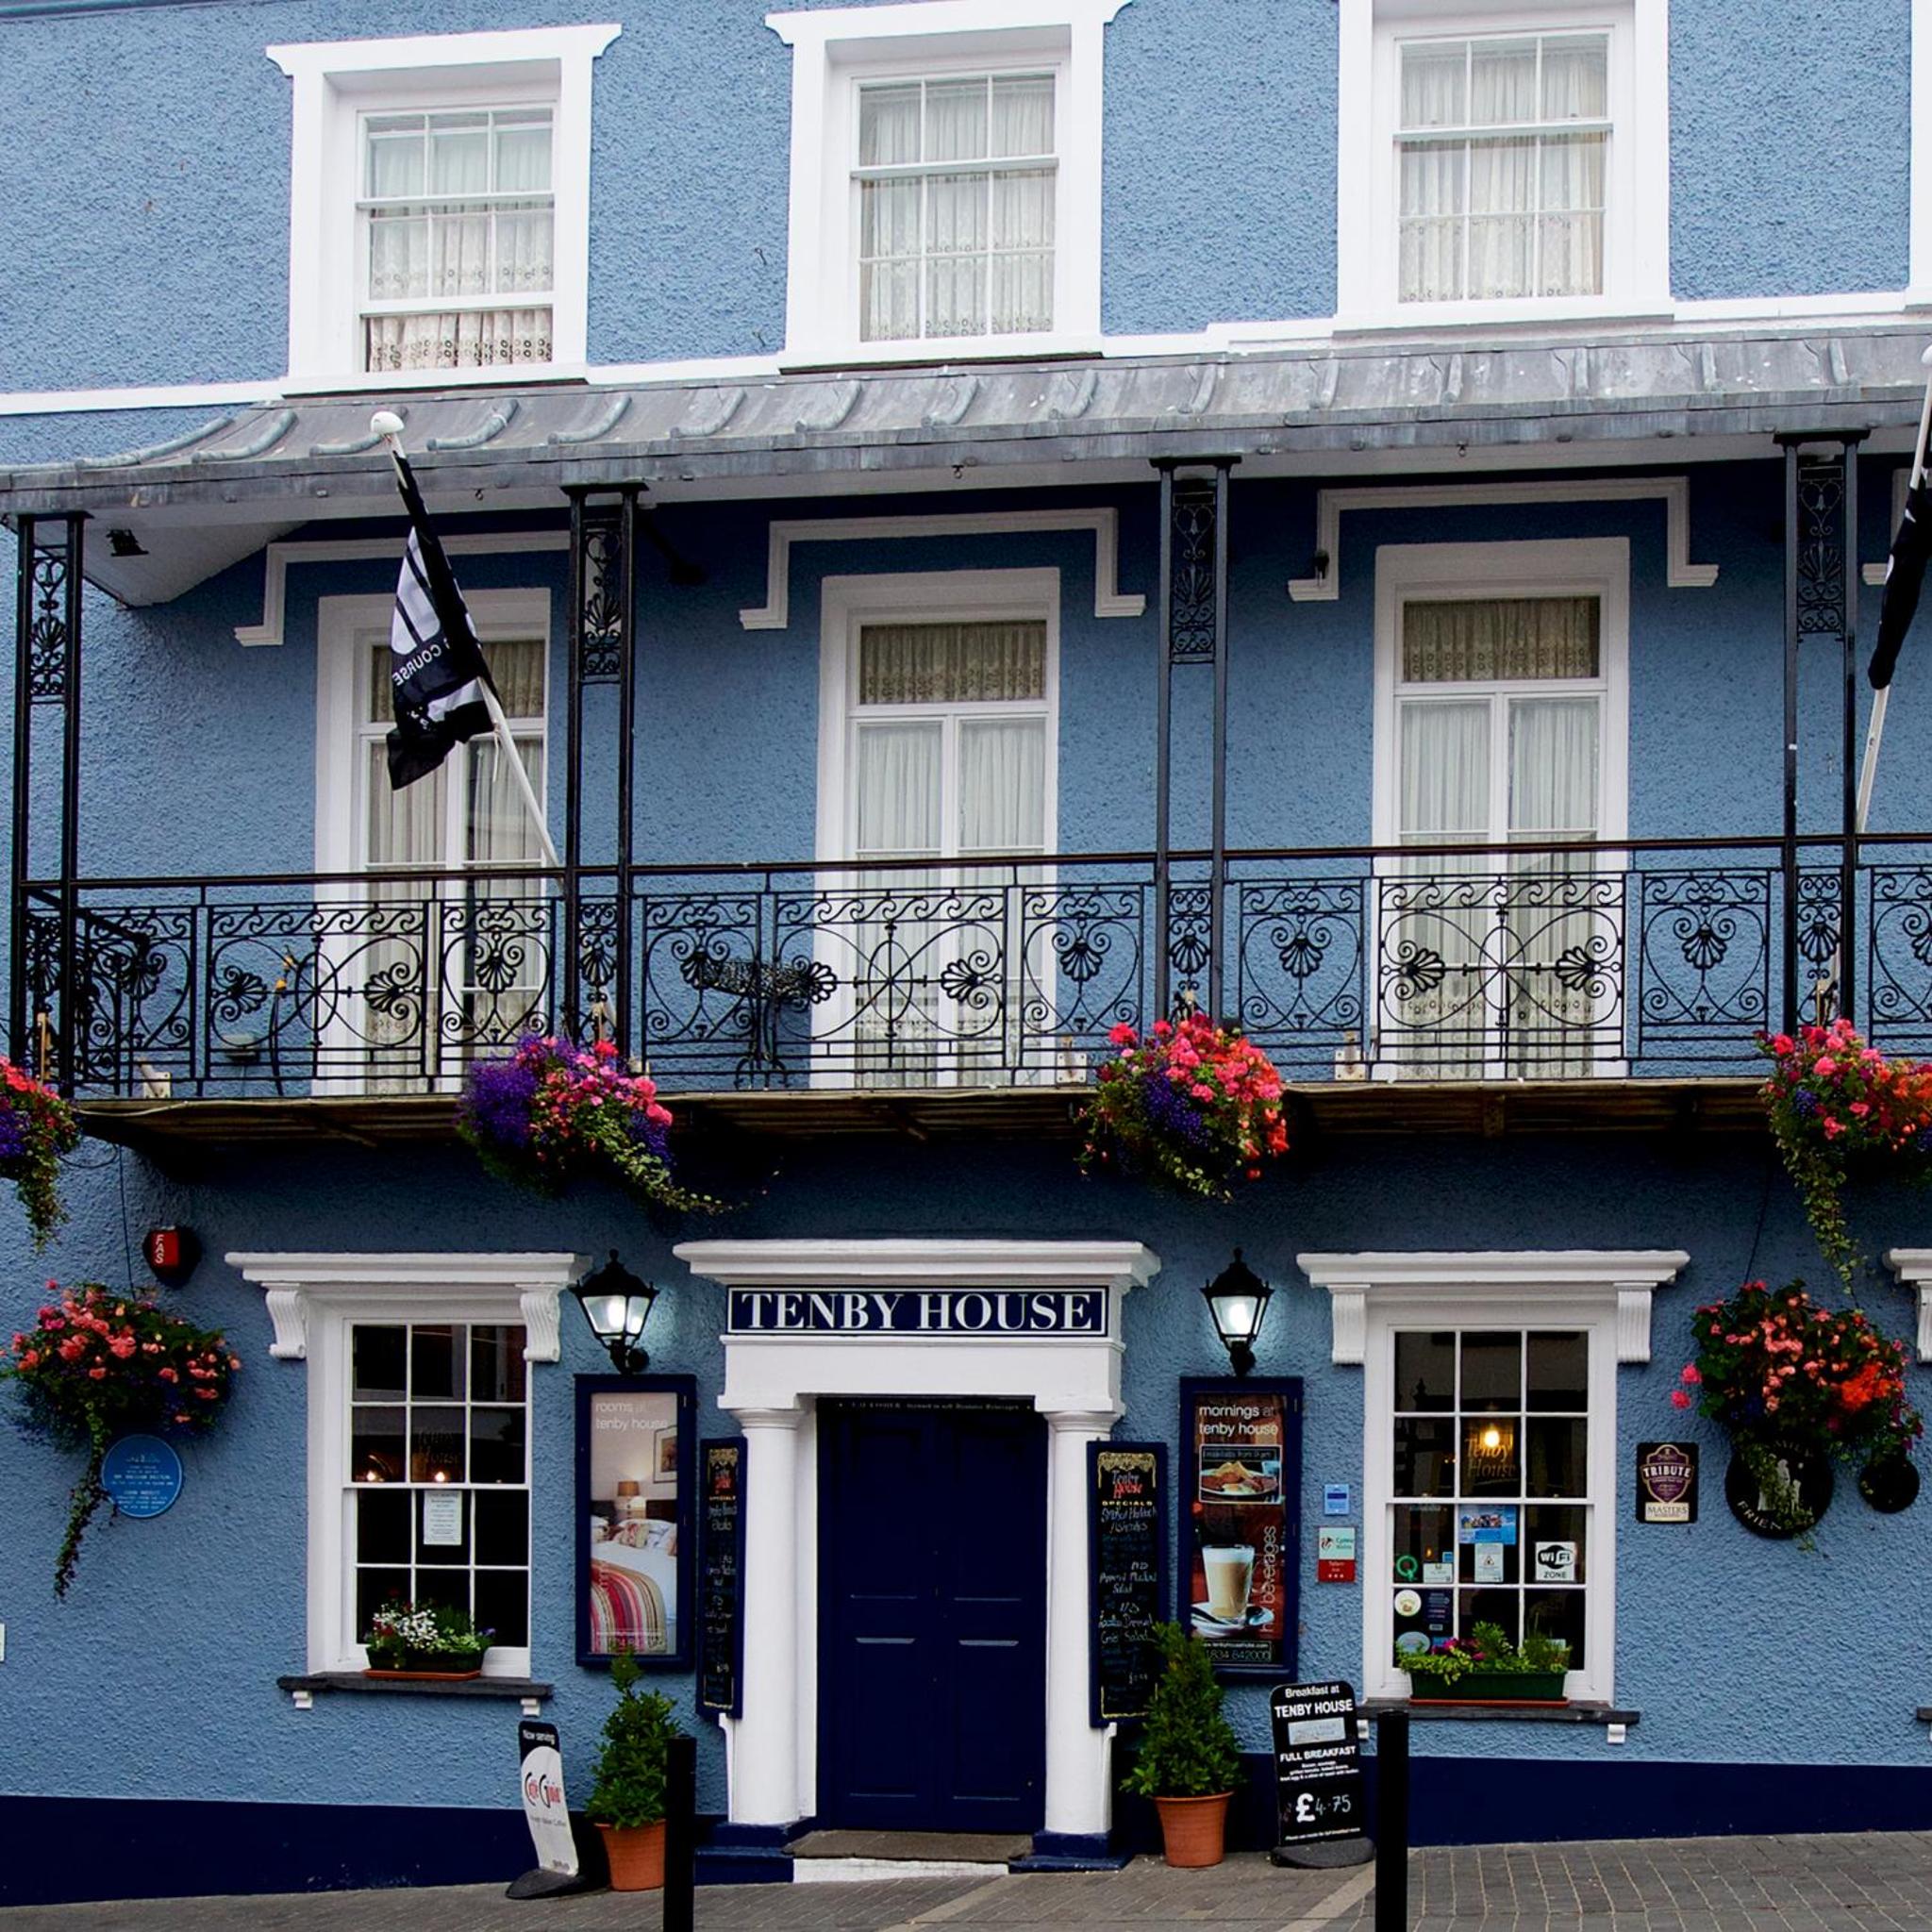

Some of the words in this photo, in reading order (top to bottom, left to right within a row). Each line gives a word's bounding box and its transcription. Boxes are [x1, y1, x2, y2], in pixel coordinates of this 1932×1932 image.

[155, 1234, 165, 1263] FAS
[741, 1293, 903, 1329] TENBY
[916, 1293, 1091, 1330] HOUSE
[595, 1403, 634, 1412] rooms
[1199, 1405, 1259, 1420] mornings
[595, 1418, 628, 1432] tenby
[631, 1418, 669, 1429] house
[1199, 1423, 1235, 1437] tenby
[1239, 1423, 1278, 1434] house
[1643, 1465, 1691, 1478] TRIBUTE
[1260, 1525, 1278, 1605] beverages
[1543, 1571, 1566, 1579] ZONE
[1285, 1686, 1329, 1698] Breakfast
[1330, 1685, 1341, 1694] at
[1274, 1703, 1312, 1718] TENBY
[1315, 1699, 1354, 1714] HOUSE
[1280, 1752, 1303, 1762] FULL
[1304, 1745, 1357, 1760] BREAKFAST
